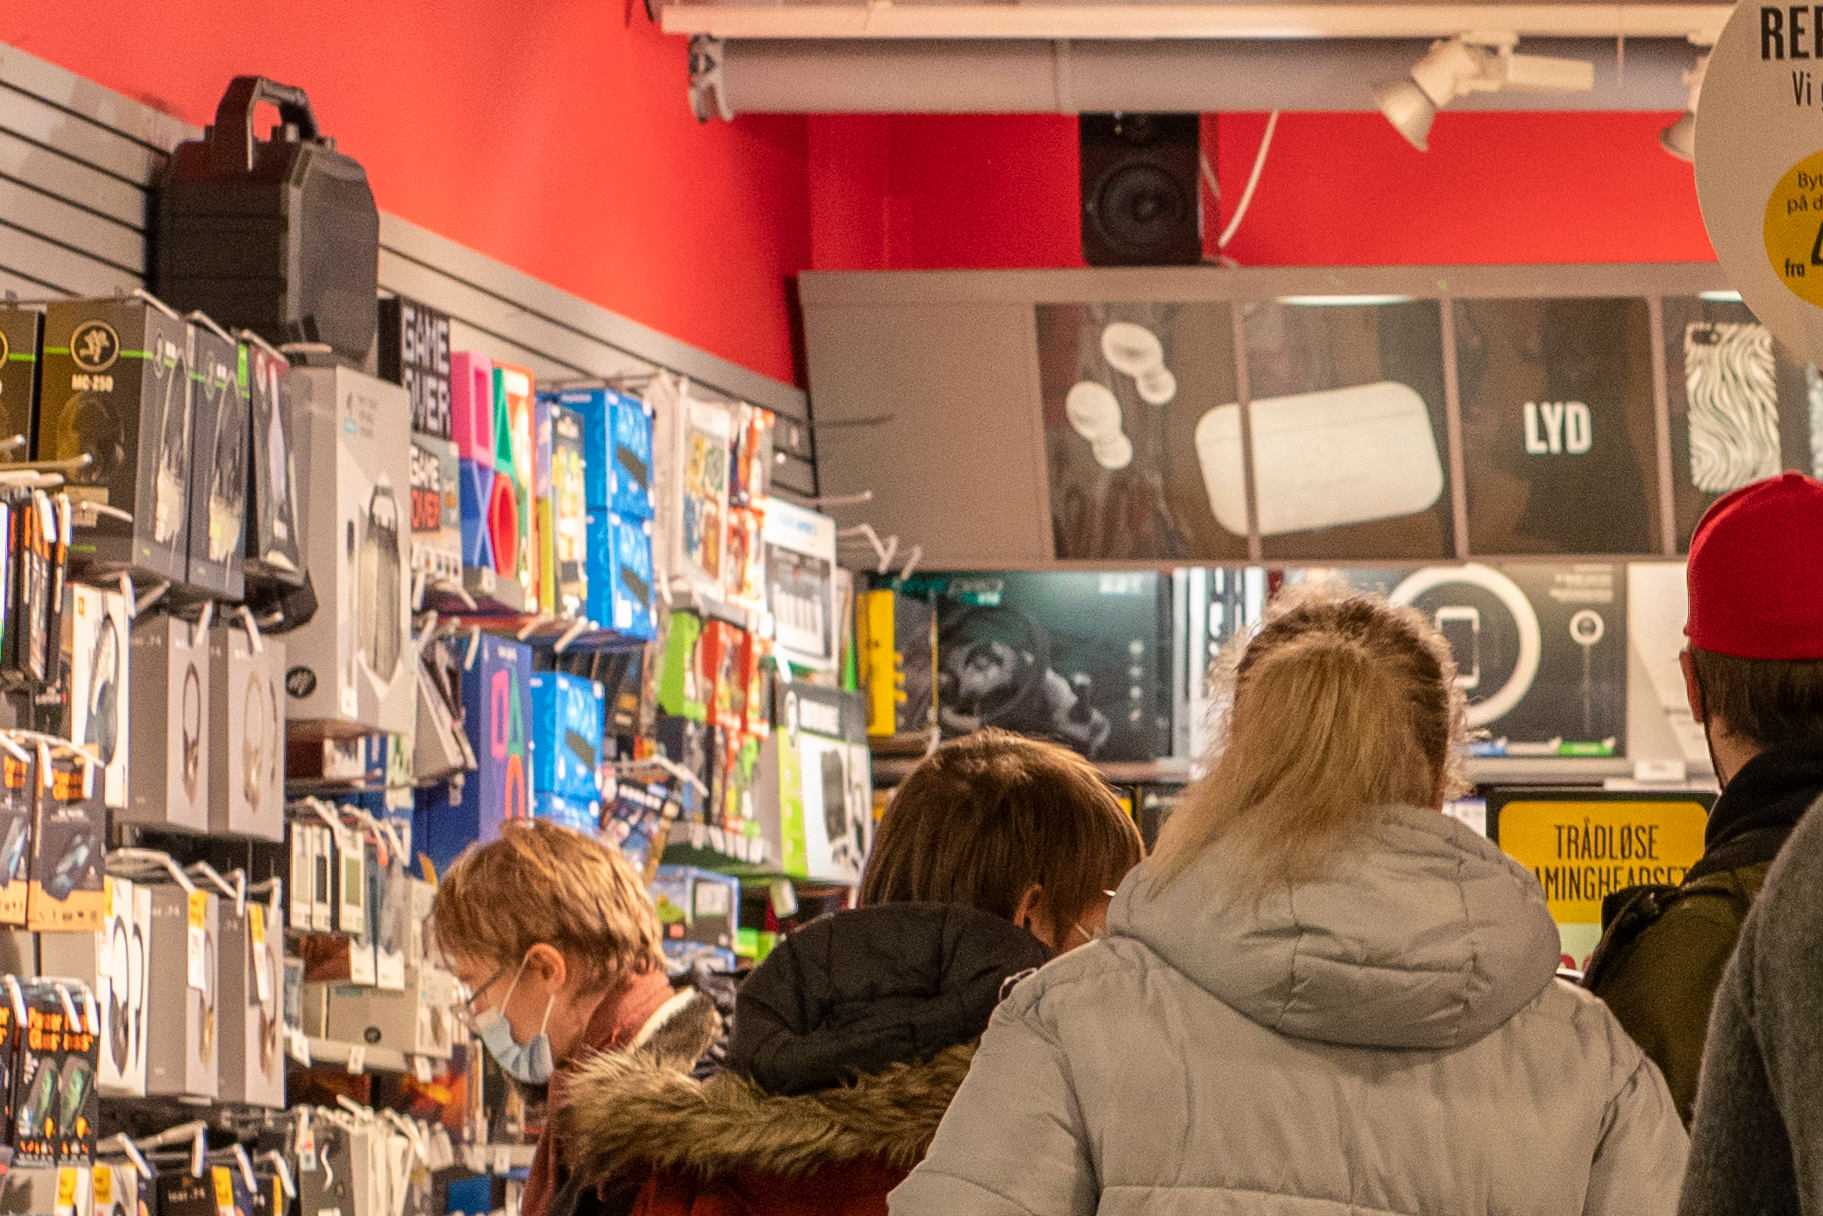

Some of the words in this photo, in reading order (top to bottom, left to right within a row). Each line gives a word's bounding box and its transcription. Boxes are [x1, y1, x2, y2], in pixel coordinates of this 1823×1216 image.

[1792, 70, 1811, 107] Vi
[1523, 401, 1592, 455] LYD
[1554, 816, 1660, 861] TRÅDLØSE
